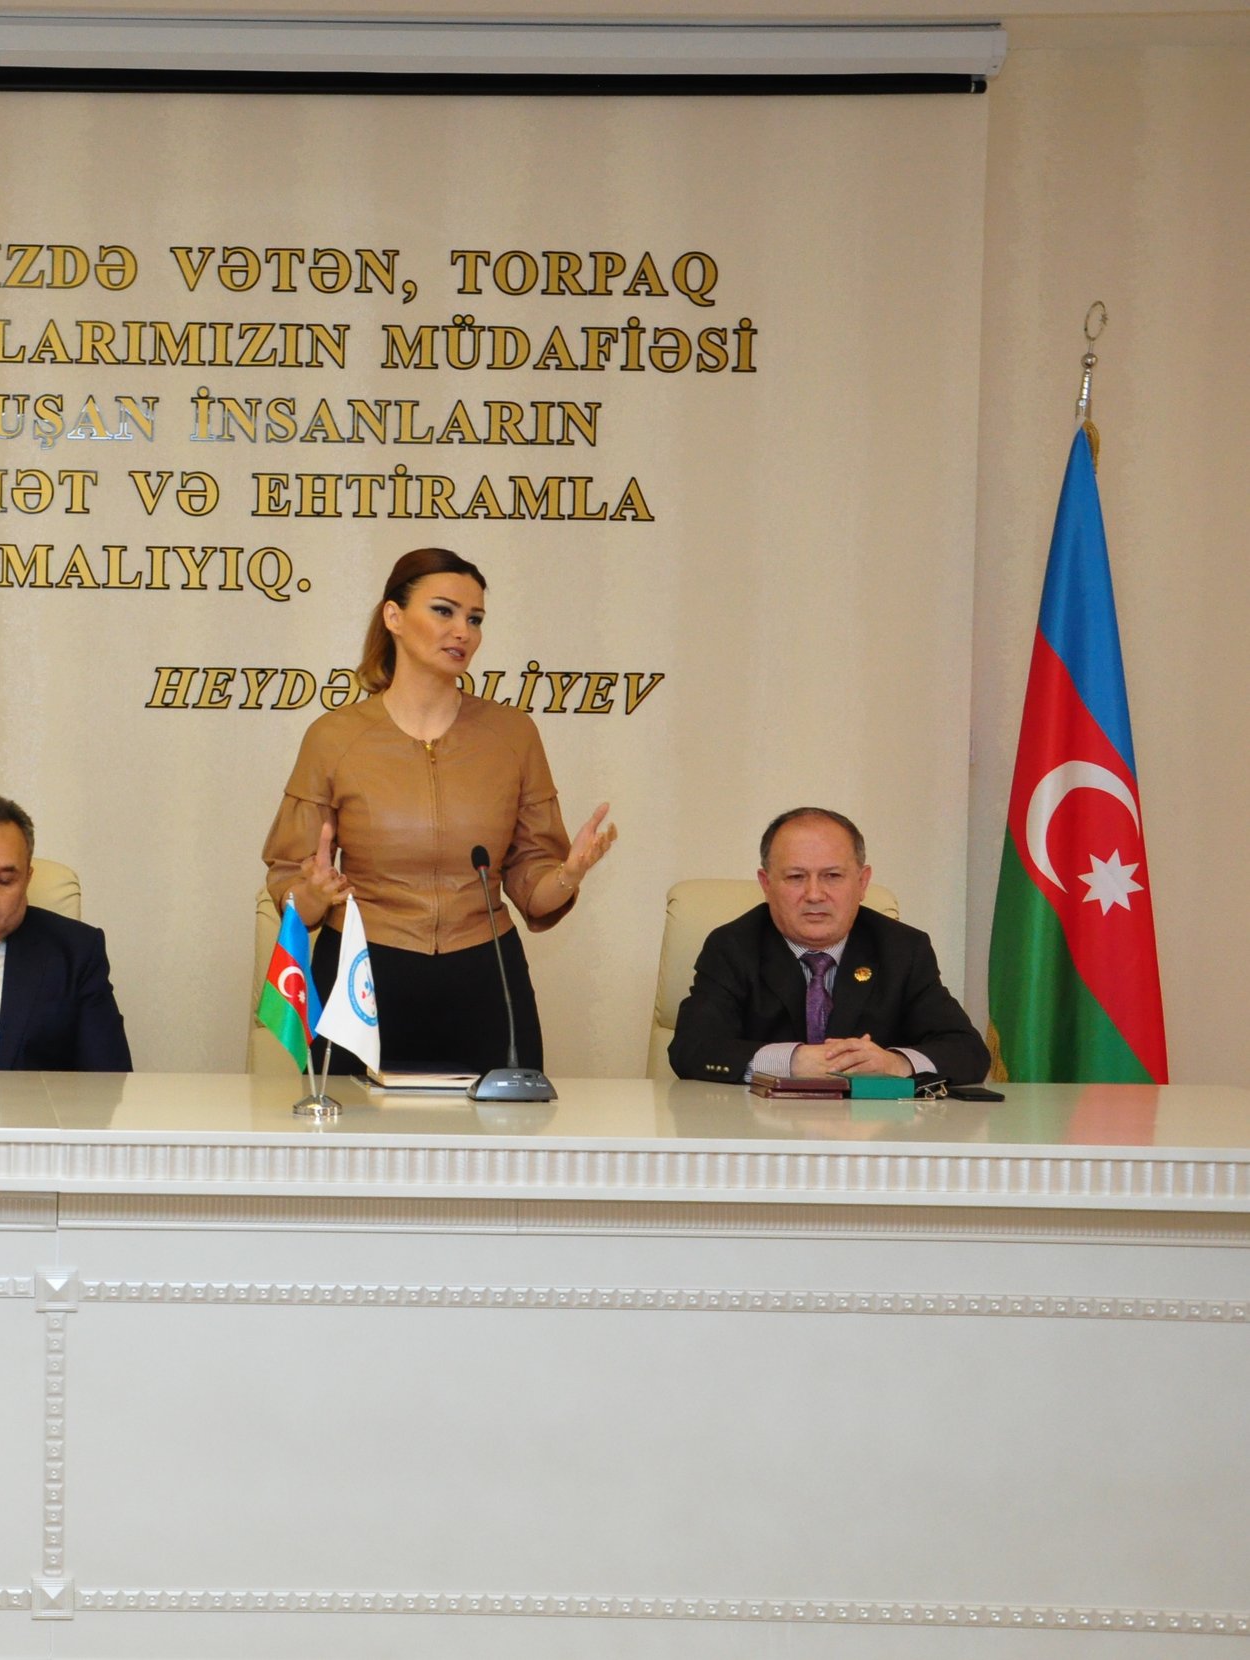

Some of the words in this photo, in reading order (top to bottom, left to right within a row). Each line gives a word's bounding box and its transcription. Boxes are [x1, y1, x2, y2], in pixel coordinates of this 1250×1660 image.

[170, 246, 418, 303] VƏTƏN,
[451, 250, 719, 306] TORPAQ
[382, 315, 757, 373] MÜDAFİƏSİ
[191, 387, 602, 446] İNSANLARIN
[129, 471, 220, 516] VƏ
[252, 464, 655, 521] EHTİRAMLA
[146, 667, 372, 711] HEYDƏ
